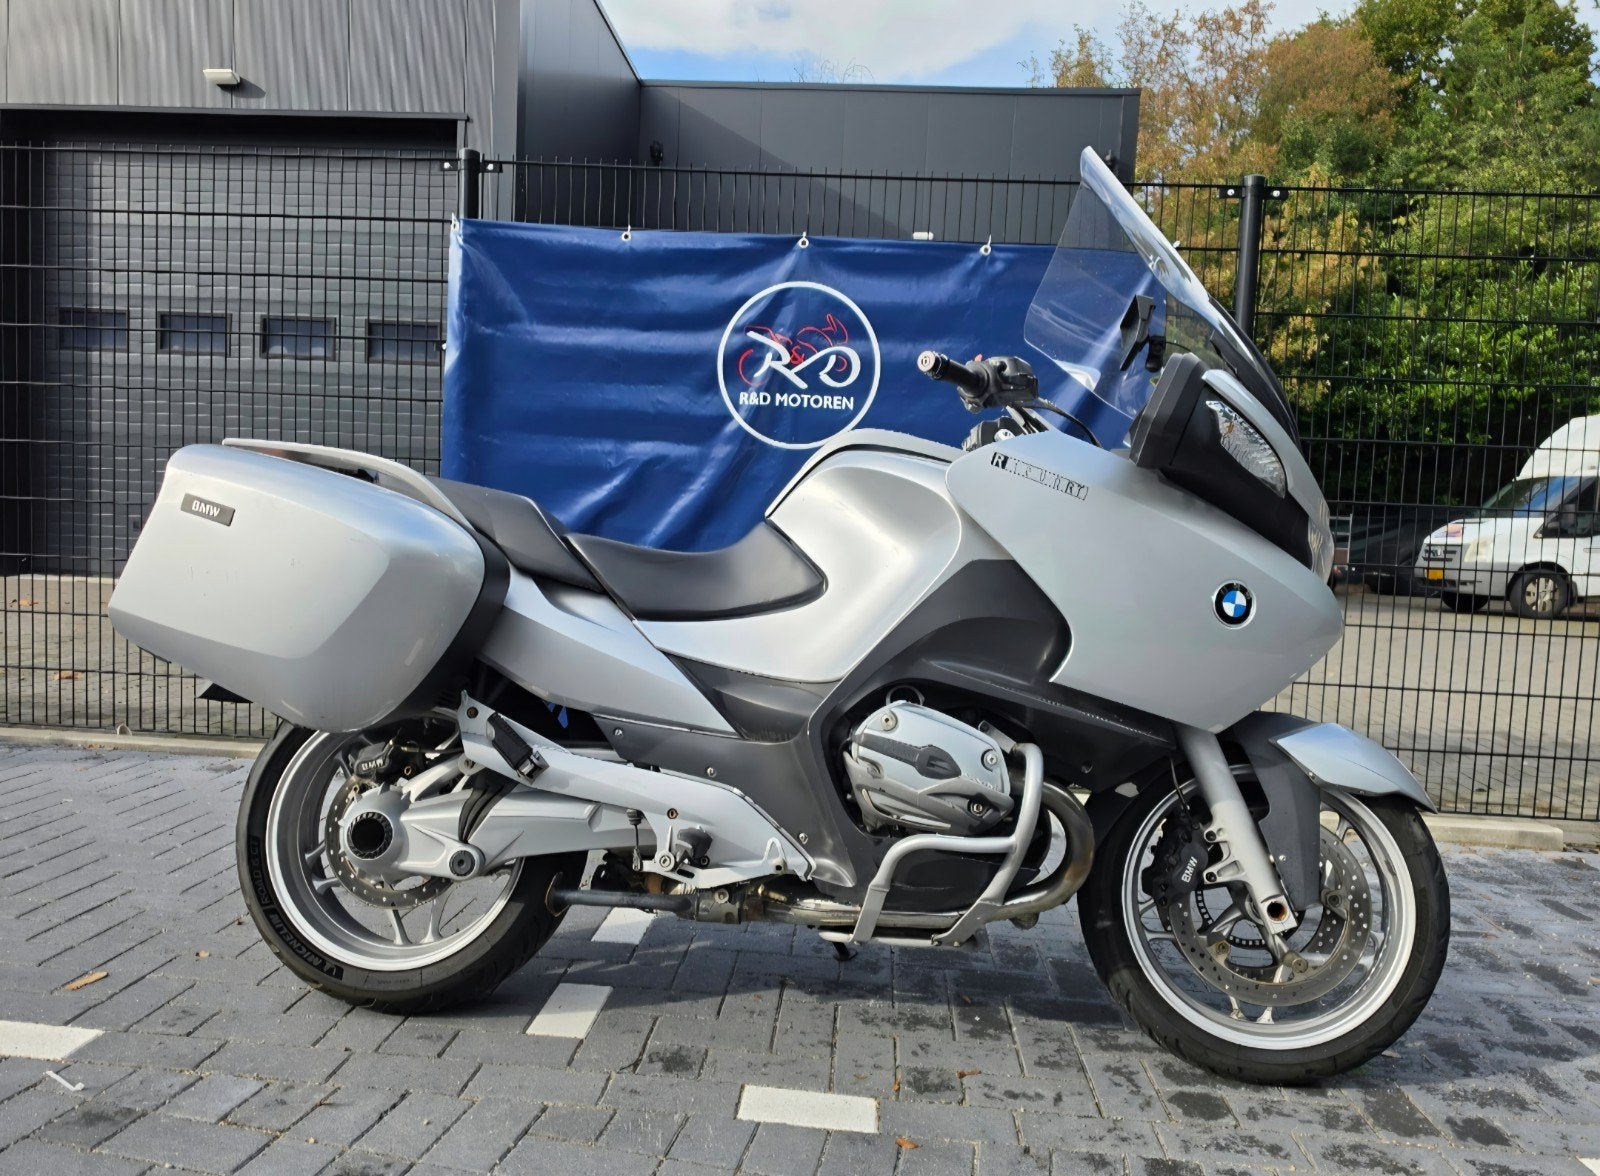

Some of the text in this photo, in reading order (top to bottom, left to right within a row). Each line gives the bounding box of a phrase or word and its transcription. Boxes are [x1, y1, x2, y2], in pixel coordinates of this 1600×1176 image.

[739, 391, 854, 410] R&D MOTOREN
[191, 500, 221, 517] BMW
[1181, 856, 1198, 883] BMW
[268, 912, 321, 966] MICHELIN
